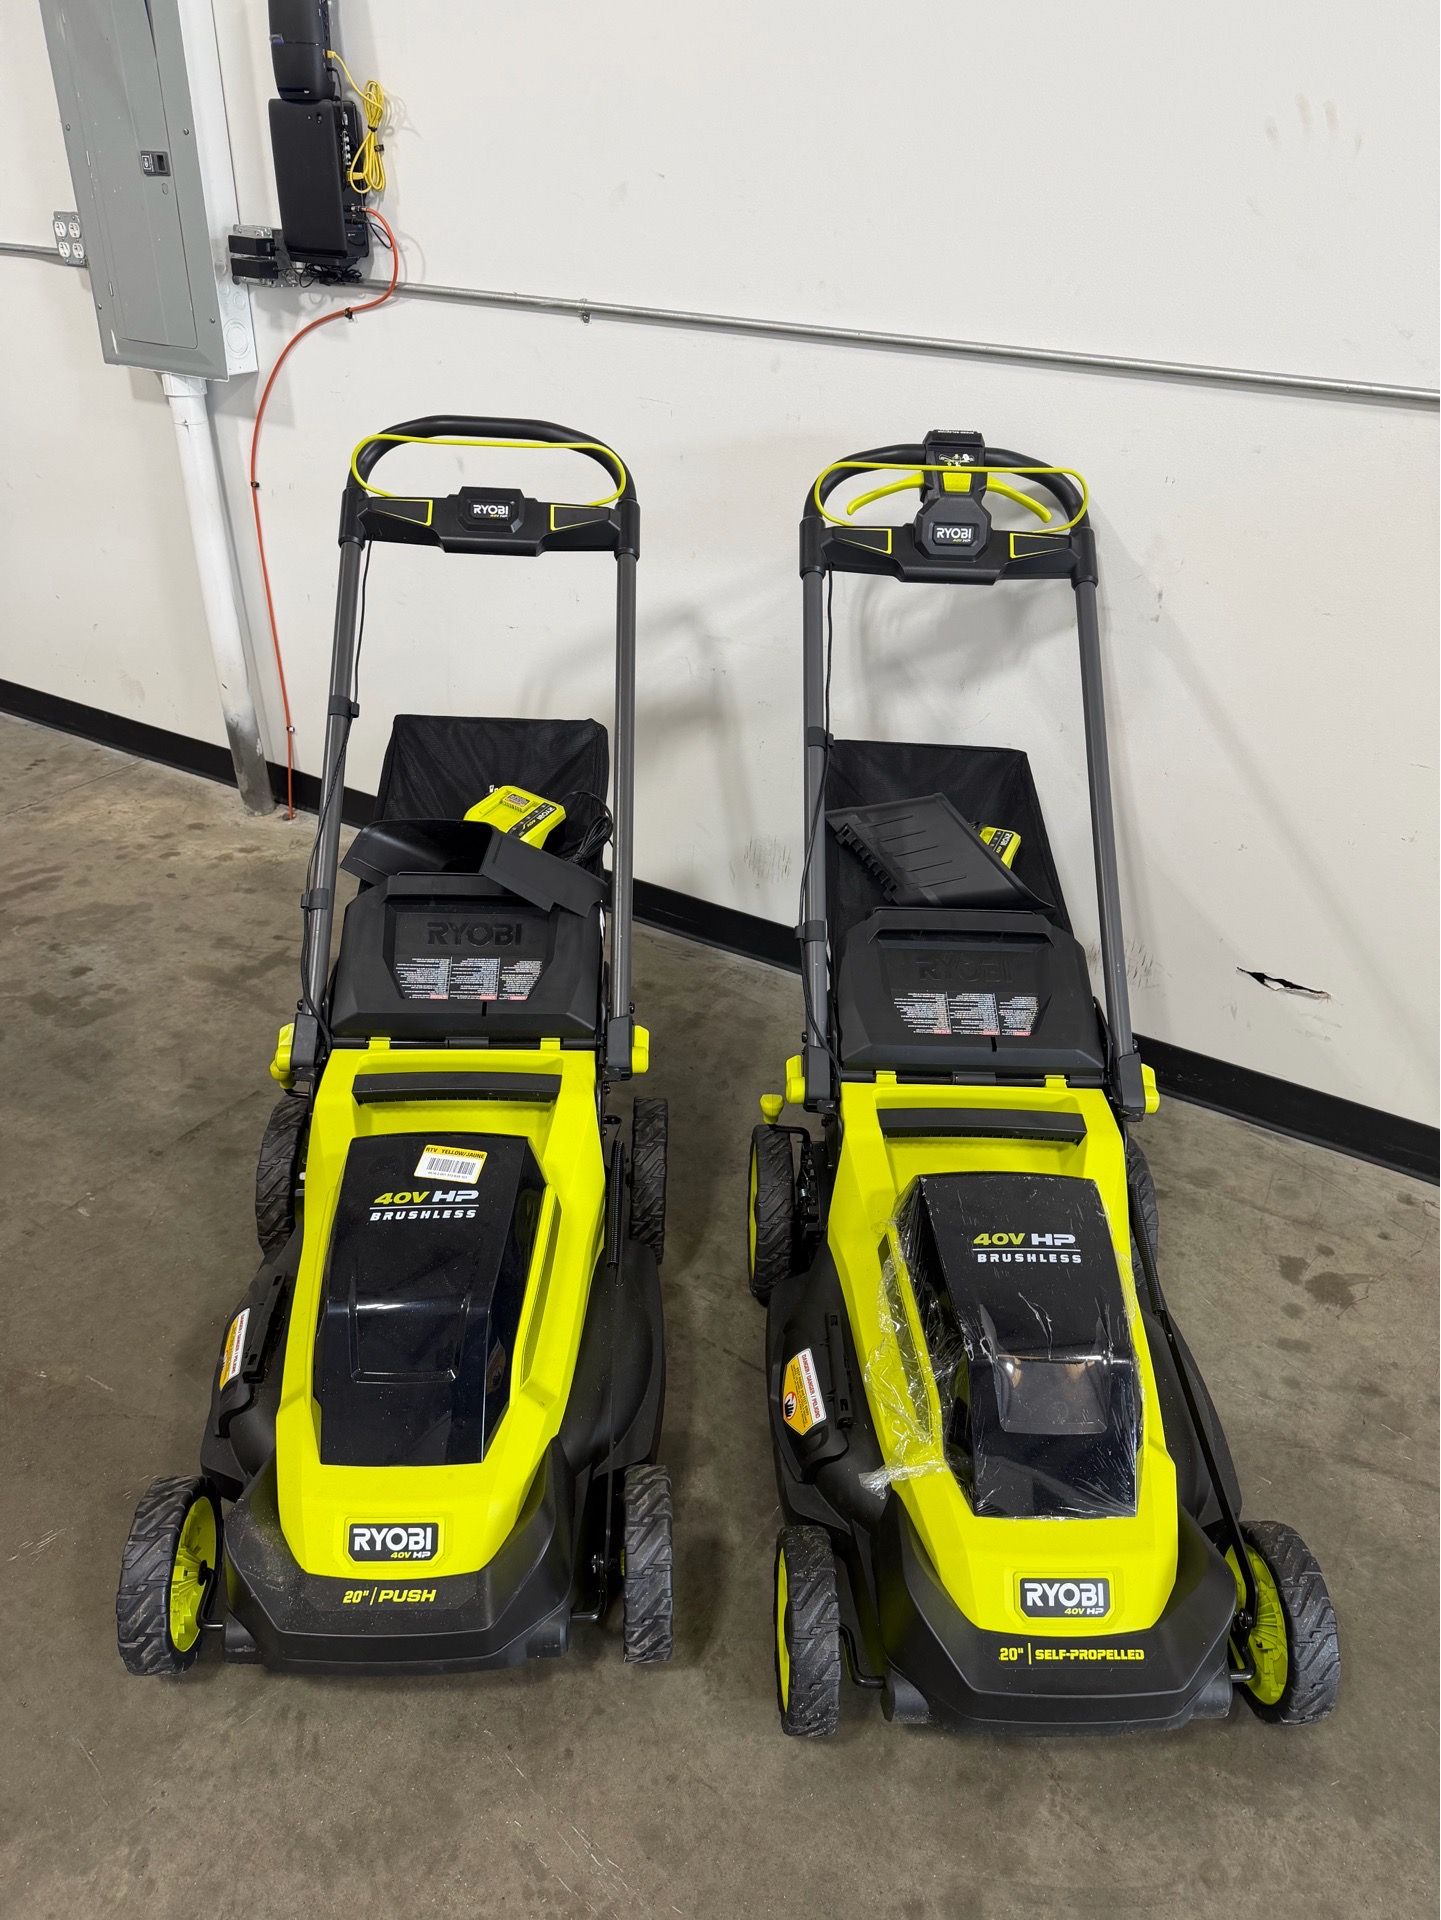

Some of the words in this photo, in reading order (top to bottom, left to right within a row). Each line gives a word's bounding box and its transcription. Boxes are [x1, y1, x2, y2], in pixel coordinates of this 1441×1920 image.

[473, 504, 508, 515] RYOBI
[936, 527, 972, 539] RYOBI
[427, 921, 523, 947] RYOBI
[441, 1149, 485, 1159] YELLOW/JAUNE
[374, 1191, 430, 1204] 40V
[432, 1190, 479, 1203] HP
[370, 1209, 477, 1221] BRUSHLESS
[973, 1233, 1025, 1246] 40V
[1031, 1233, 1076, 1246] HP
[977, 1253, 1082, 1264] BRUSHLESS
[352, 1527, 432, 1551] RYOBI
[390, 1551, 411, 1559] 40V
[412, 1551, 431, 1559] HP
[378, 1589, 437, 1603] PUSH
[1024, 1583, 1104, 1607] RYOBI
[1064, 1607, 1086, 1615] 40V
[1086, 1607, 1105, 1615] HP
[1034, 1649, 1145, 1661] SELF-PROPELLED
